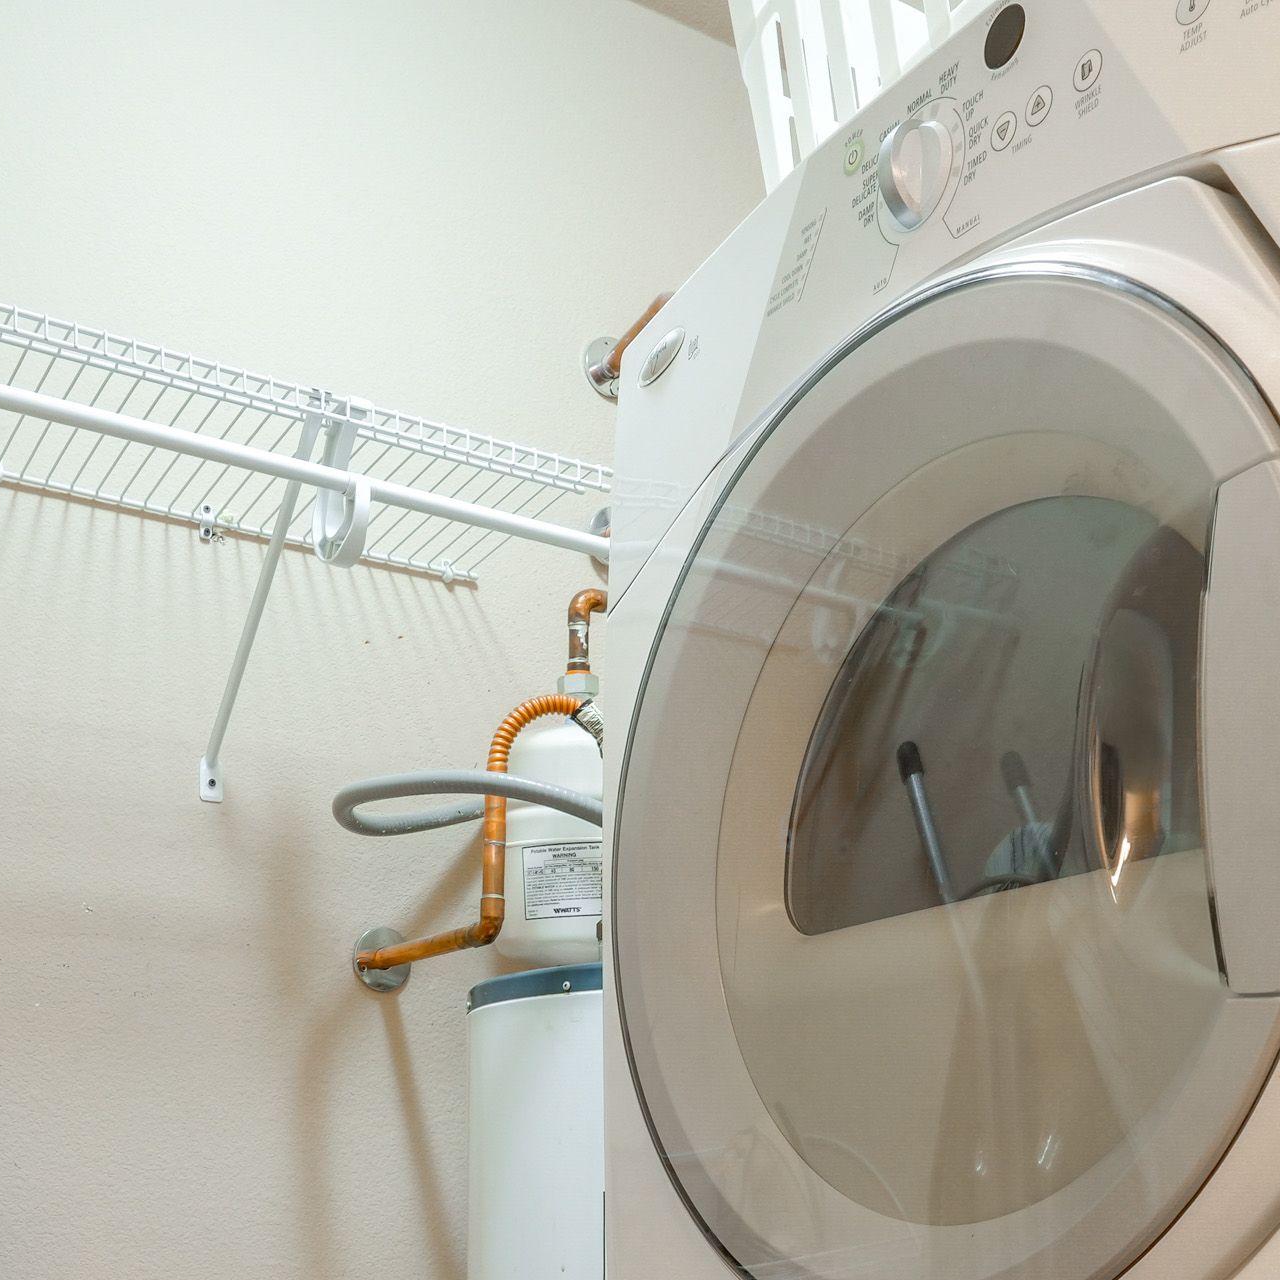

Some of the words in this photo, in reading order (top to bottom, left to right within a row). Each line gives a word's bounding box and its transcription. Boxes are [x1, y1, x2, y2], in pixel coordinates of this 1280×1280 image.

[1240, 2, 1259, 19] Auto
[1183, 22, 1204, 41] TEMP
[1179, 30, 1208, 54] ADJUST
[938, 60, 960, 85] HEAVY
[940, 75, 957, 95] DUTY
[906, 88, 933, 115] NORMAL
[962, 89, 984, 112] TOUCH
[1074, 84, 1101, 110] WRINKLE
[965, 107, 975, 121] UP
[1077, 97, 1099, 119] SHIELD
[968, 116, 989, 138] QUICK
[968, 134, 981, 150] DRY
[1011, 134, 1033, 154] TIMING
[967, 150, 987, 172] TIMED
[963, 169, 977, 186] DRY
[851, 181, 877, 208] DELICATE
[858, 201, 875, 221] DAMP
[863, 213, 875, 228] DRY
[873, 277, 888, 291] AUTO
